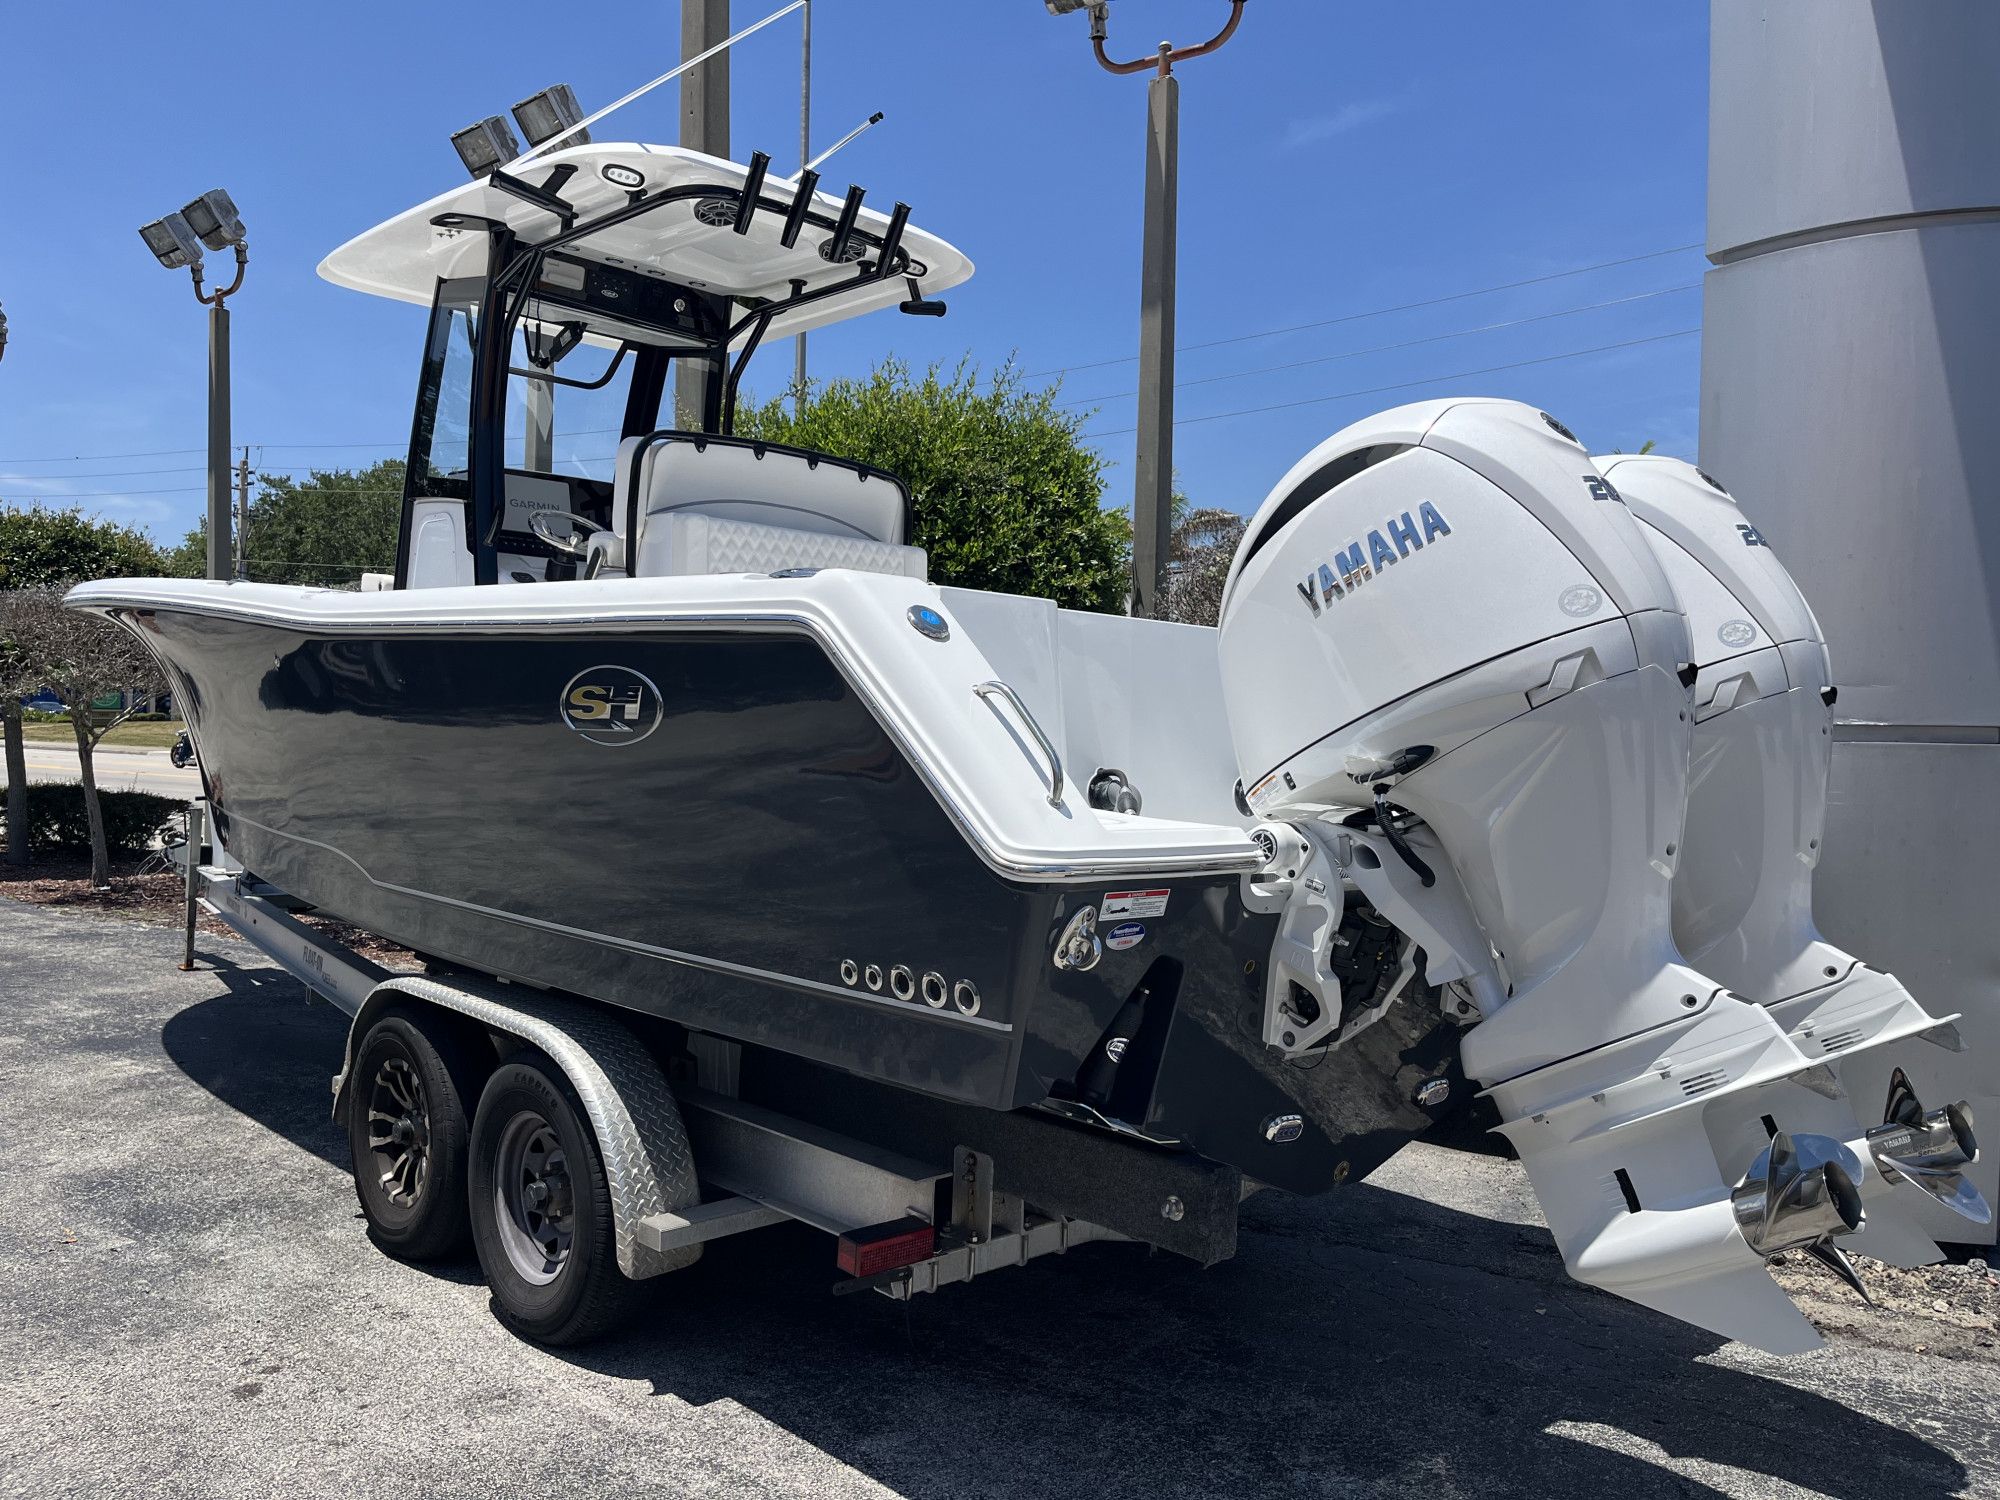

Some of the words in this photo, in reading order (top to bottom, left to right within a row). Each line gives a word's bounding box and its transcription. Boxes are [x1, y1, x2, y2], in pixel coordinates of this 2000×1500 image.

[510, 498, 560, 511] GARMIN
[1296, 500, 1452, 619] YAMAHA
[568, 686, 643, 720] SH
[1884, 1135, 1912, 1149] YAMAHA
